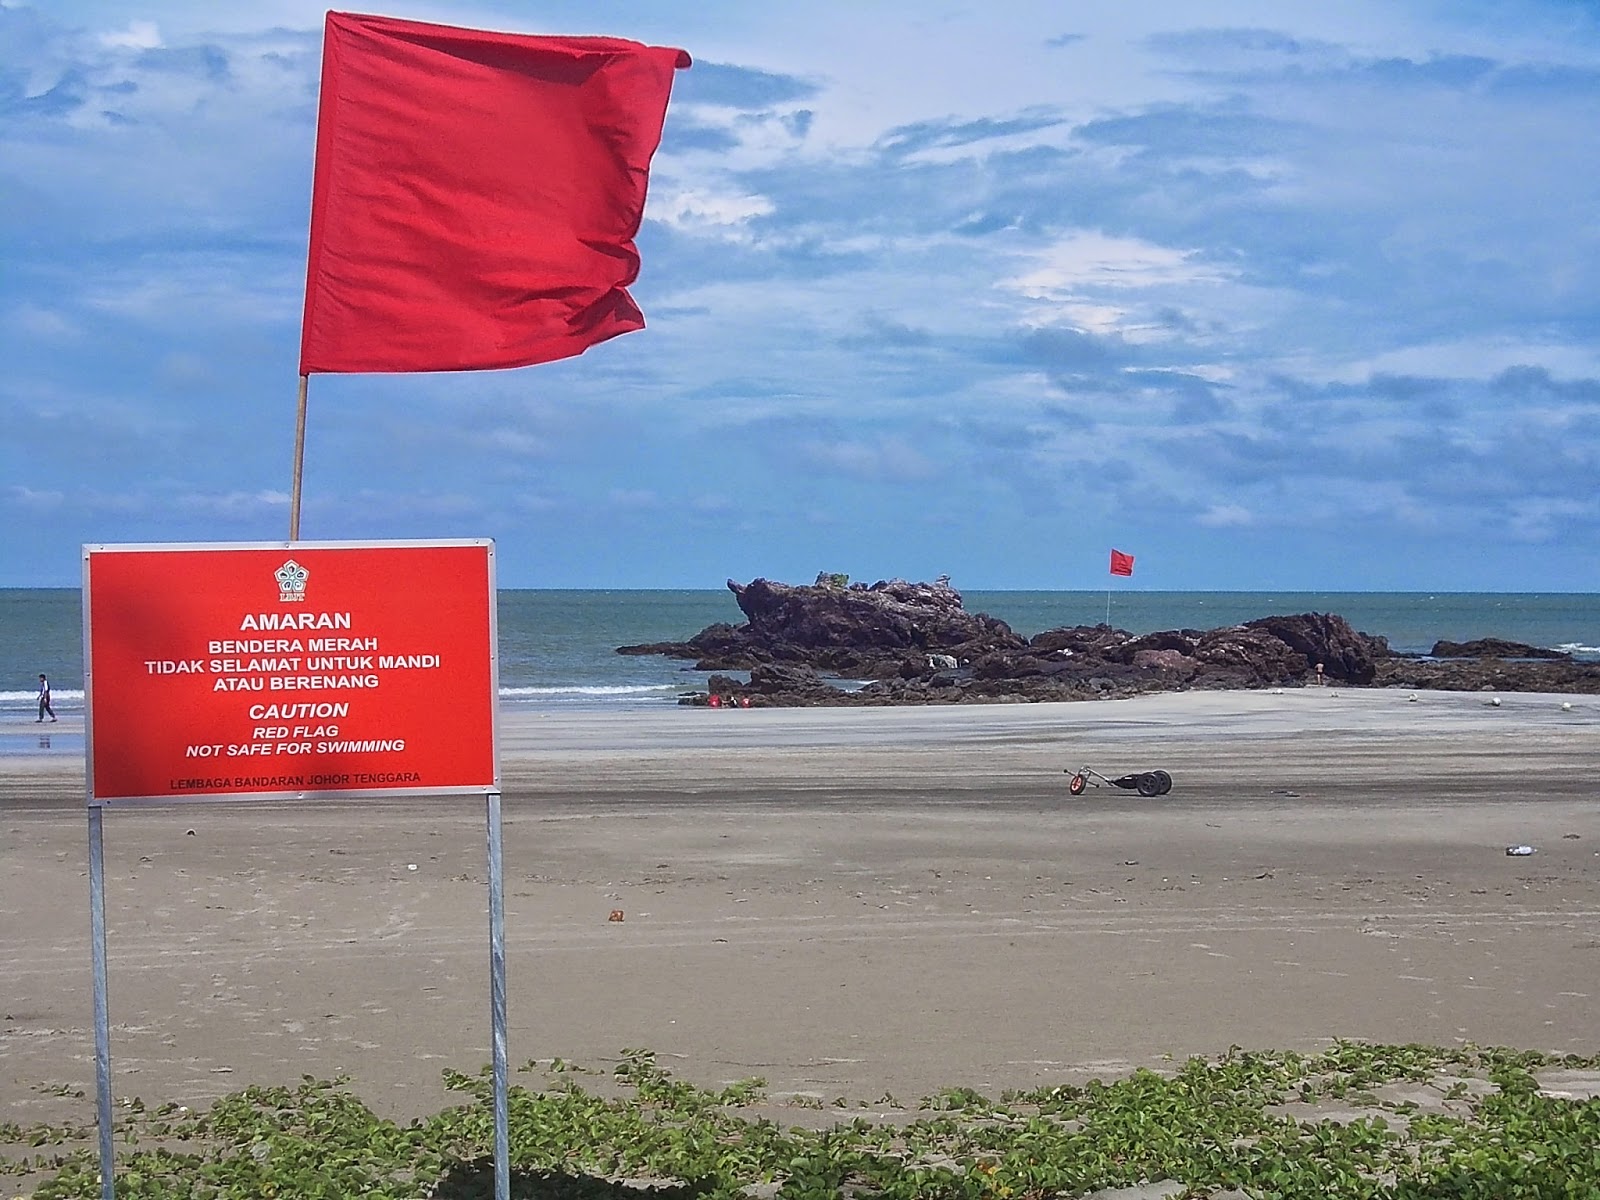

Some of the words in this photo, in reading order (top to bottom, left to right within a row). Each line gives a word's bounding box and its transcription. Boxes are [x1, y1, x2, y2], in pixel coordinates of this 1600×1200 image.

[240, 612, 351, 631] AMARAN
[208, 639, 305, 654] BENDERA
[308, 637, 378, 652] MERAH
[144, 659, 205, 674] TIDAK
[209, 657, 302, 673] SELAMAT
[306, 656, 374, 671] UNTUK
[378, 654, 440, 669] MANDI
[213, 677, 264, 692] ATAU
[270, 674, 379, 691] BERENANG
[249, 702, 349, 720] CAUTION
[252, 726, 289, 739] RED
[292, 725, 339, 738] FLAG
[186, 744, 224, 757] NOT
[226, 743, 272, 756] SAFE
[275, 742, 312, 755] FOR
[316, 739, 405, 754] SWIMMING
[170, 776, 232, 790] LEMBAGA
[234, 774, 304, 788] BANDARAN
[307, 773, 350, 785] JOHOR
[352, 771, 421, 784] TENGGARA
